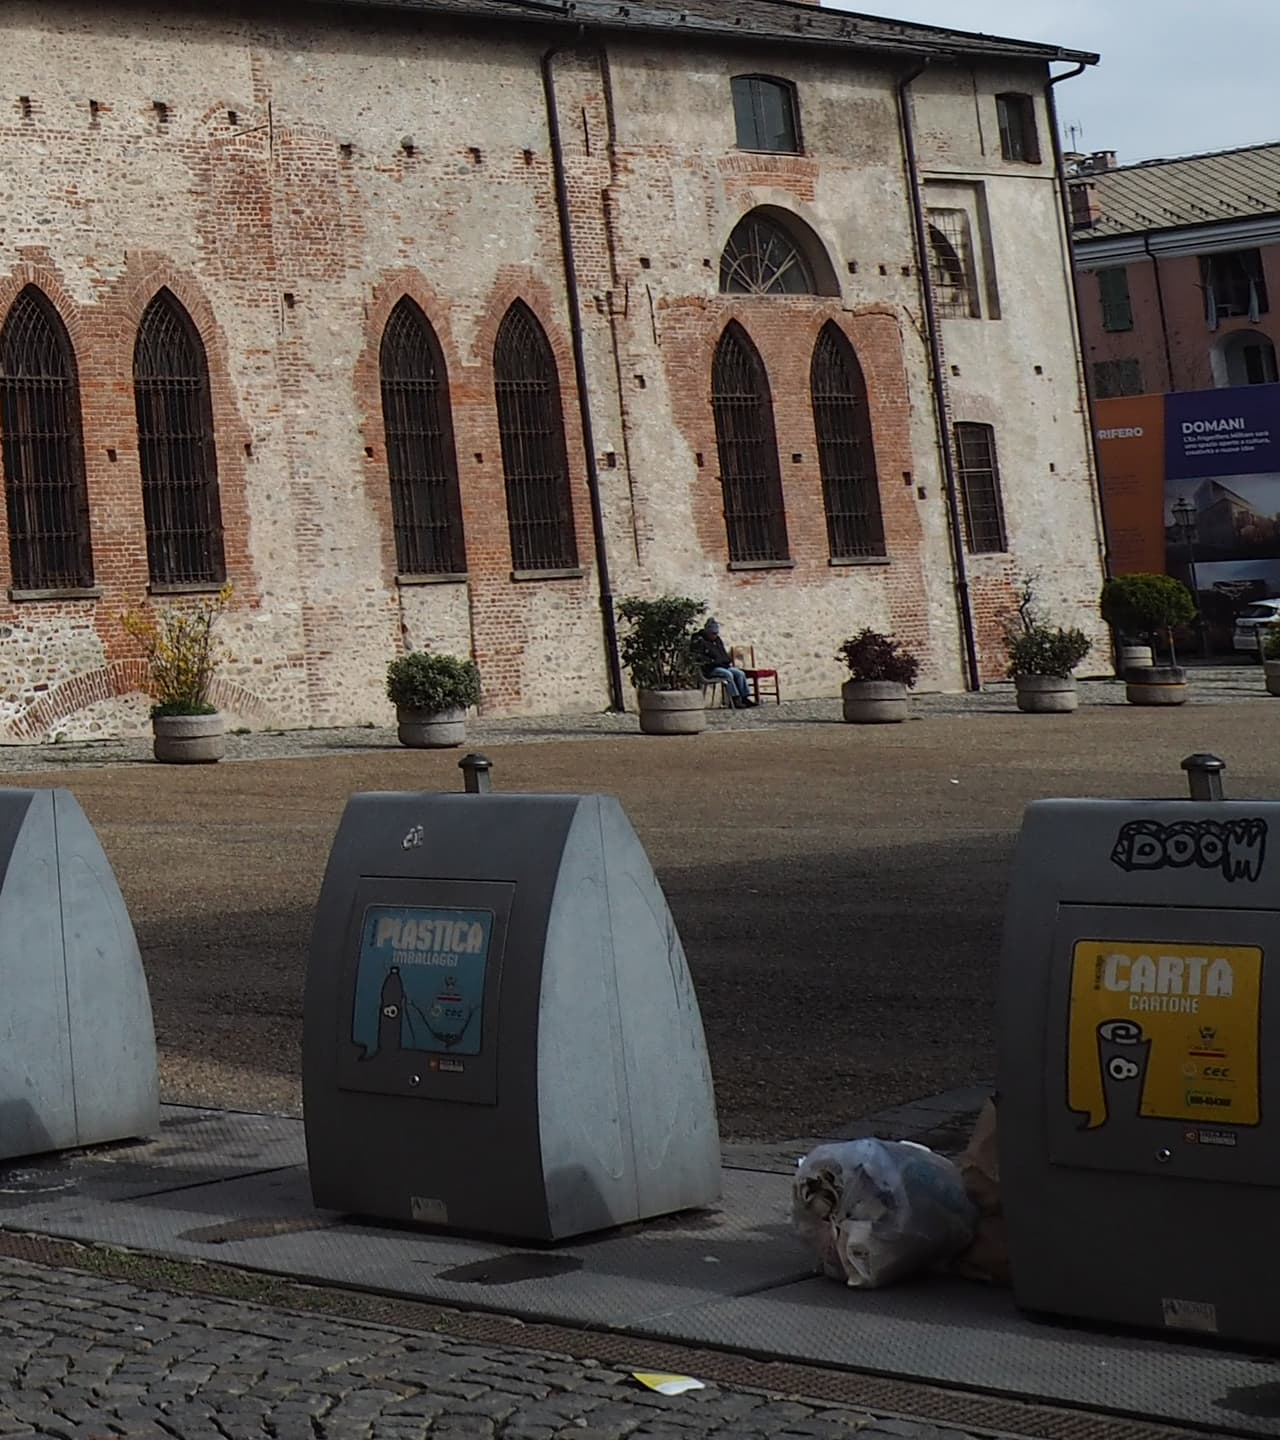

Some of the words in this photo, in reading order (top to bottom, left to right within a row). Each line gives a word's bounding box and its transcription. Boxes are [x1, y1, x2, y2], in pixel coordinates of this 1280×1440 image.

[1182, 417, 1245, 434] DOMANI
[376, 917, 484, 954] PLASTICA
[392, 951, 459, 967] IMBALLAGGI
[1104, 953, 1234, 997] CARTA
[1128, 994, 1200, 1014] CARTONE
[1202, 1064, 1231, 1078] cec
